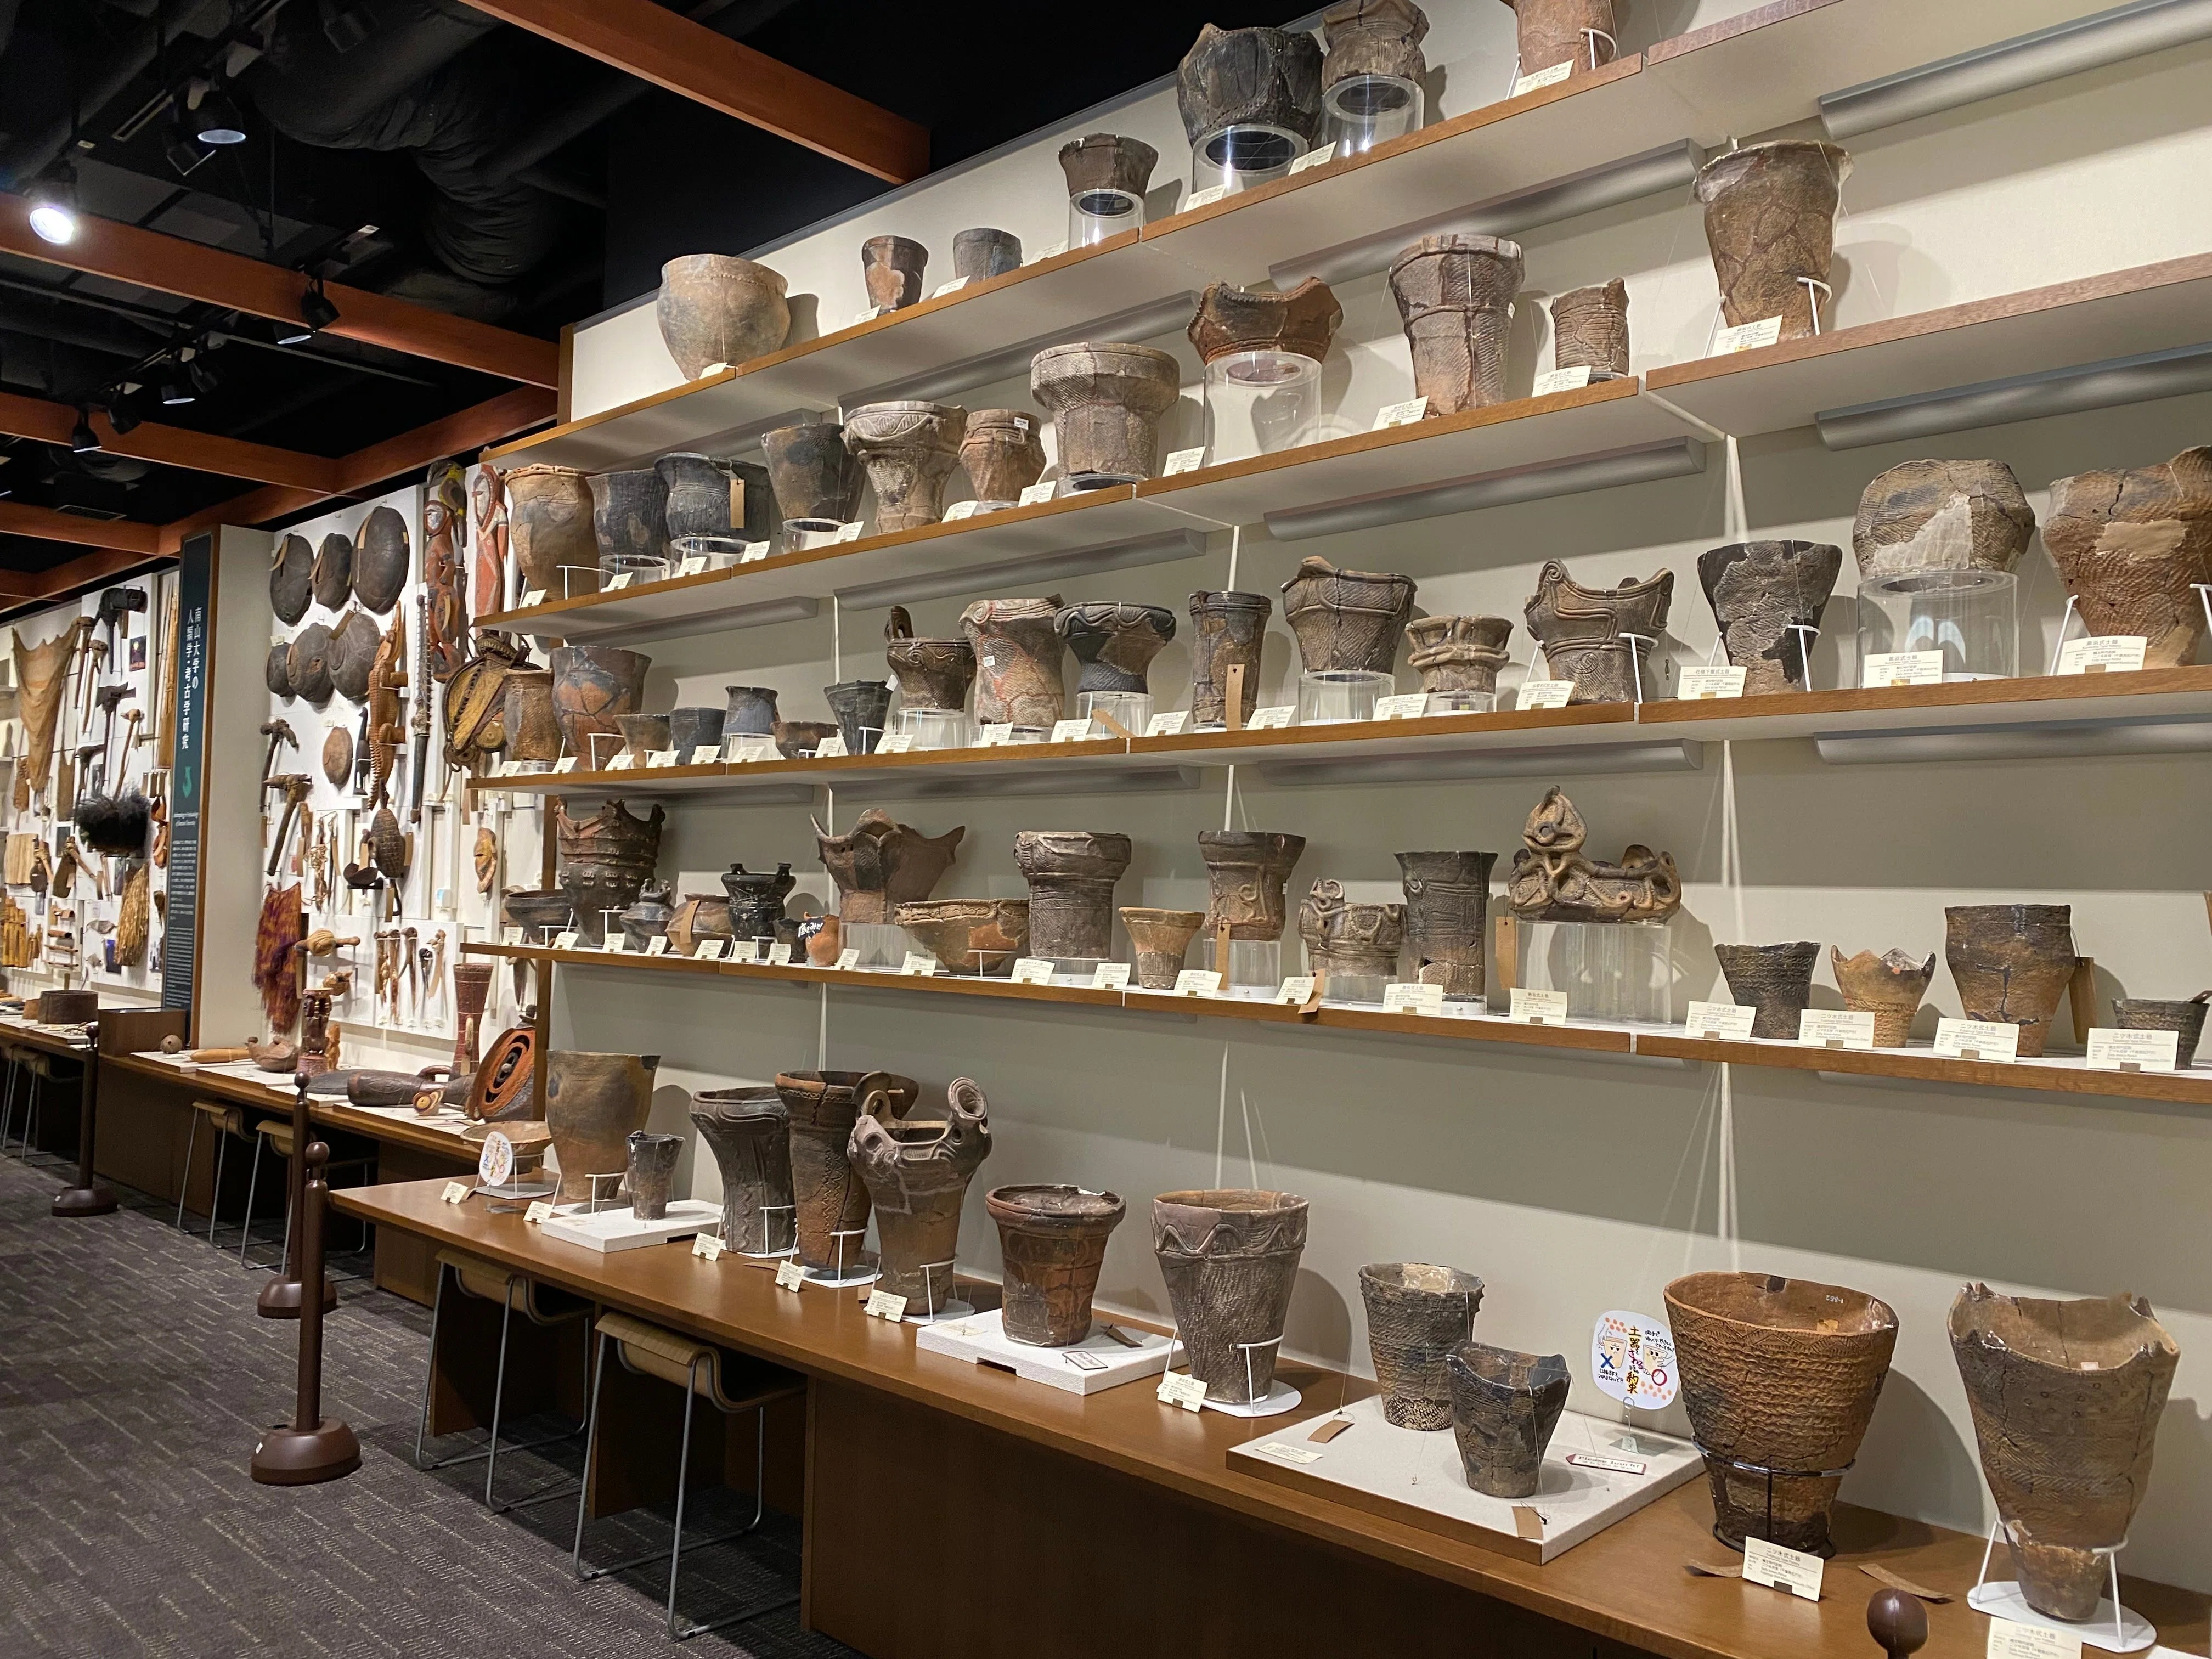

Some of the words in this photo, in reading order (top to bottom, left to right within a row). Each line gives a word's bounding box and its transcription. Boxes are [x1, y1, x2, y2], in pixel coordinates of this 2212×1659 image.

[192, 606, 202, 689] 南山大学の
[182, 609, 194, 749] 人類学・考古学研究
[1961, 1023, 1996, 1031] 二ツ木式土器
[1767, 1548, 1801, 1561] 二ツ木式土器
